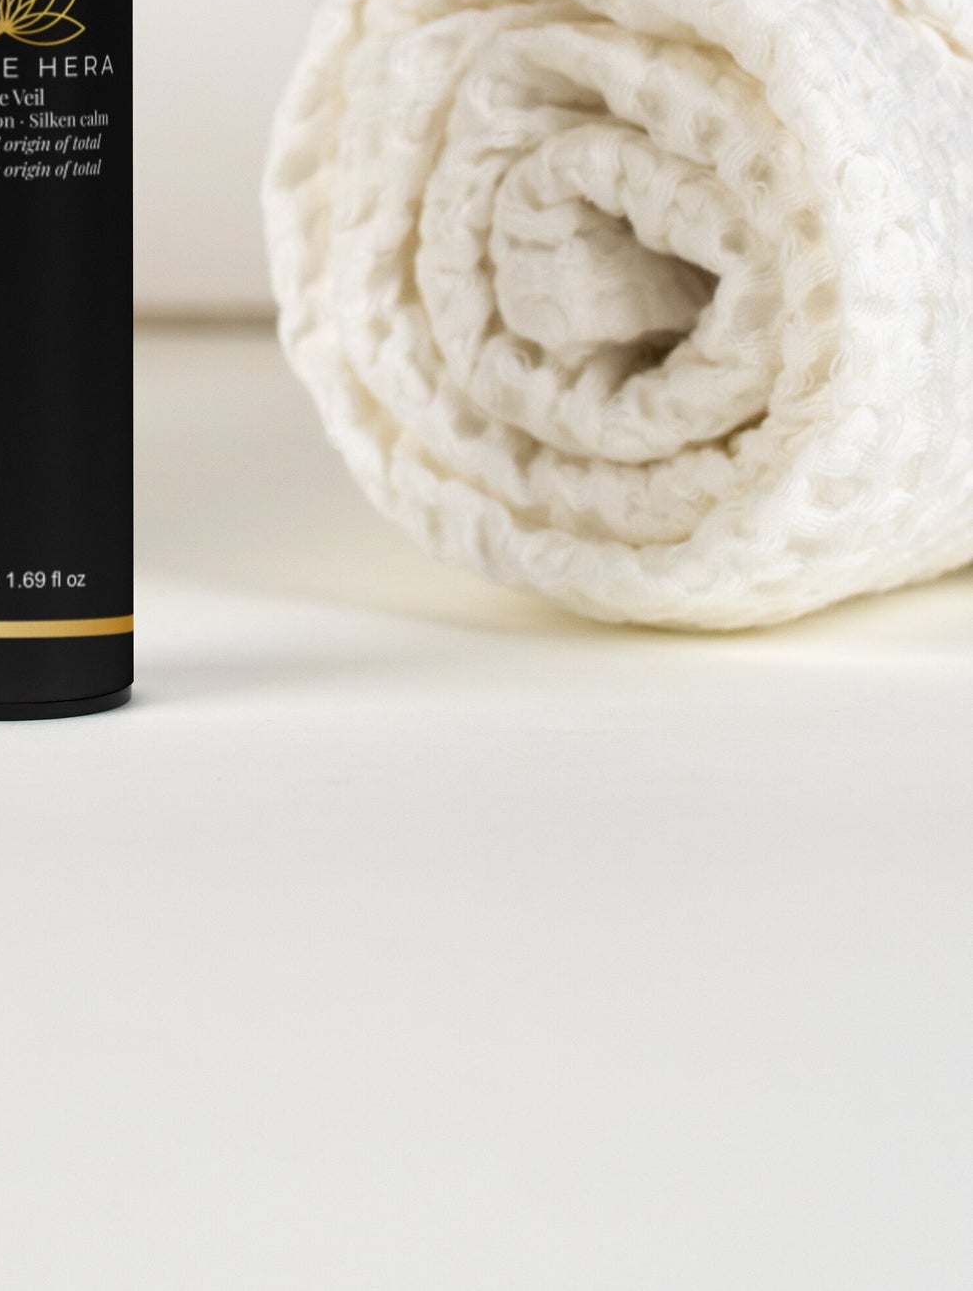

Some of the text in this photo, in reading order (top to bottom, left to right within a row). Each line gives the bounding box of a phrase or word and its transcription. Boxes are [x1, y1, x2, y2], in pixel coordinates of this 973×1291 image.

[39, 54, 114, 78] HERA
[12, 88, 45, 107] Veil
[29, 112, 76, 128] Silken
[79, 109, 109, 127] calm
[4, 136, 50, 155] origin
[55, 136, 72, 154] of
[72, 134, 102, 150] total
[3, 161, 50, 181] origin
[55, 160, 72, 180] of
[72, 159, 102, 176] total
[6, 570, 47, 589] 1.69
[51, 569, 62, 588] fl
[66, 573, 86, 588] oz
